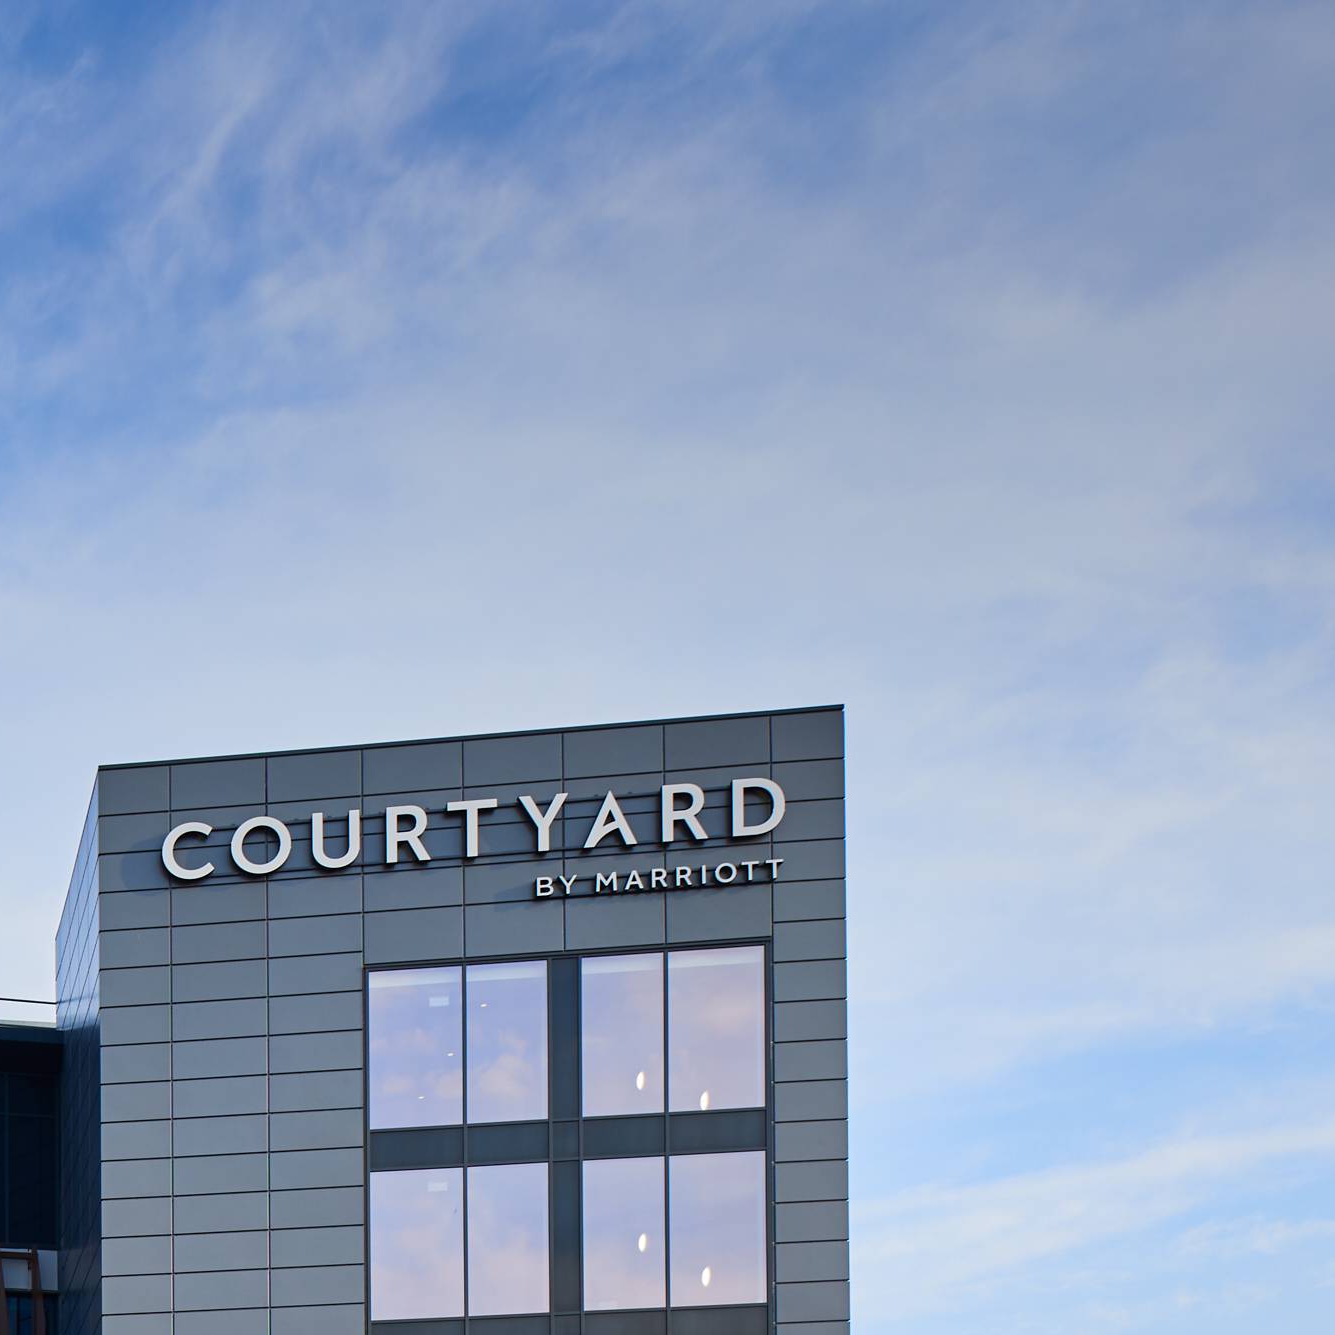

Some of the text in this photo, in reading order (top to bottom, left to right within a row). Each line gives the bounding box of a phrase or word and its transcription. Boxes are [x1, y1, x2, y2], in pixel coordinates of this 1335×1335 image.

[161, 777, 786, 880] COURTYARD
[535, 858, 785, 897] BY MARRIOTT
